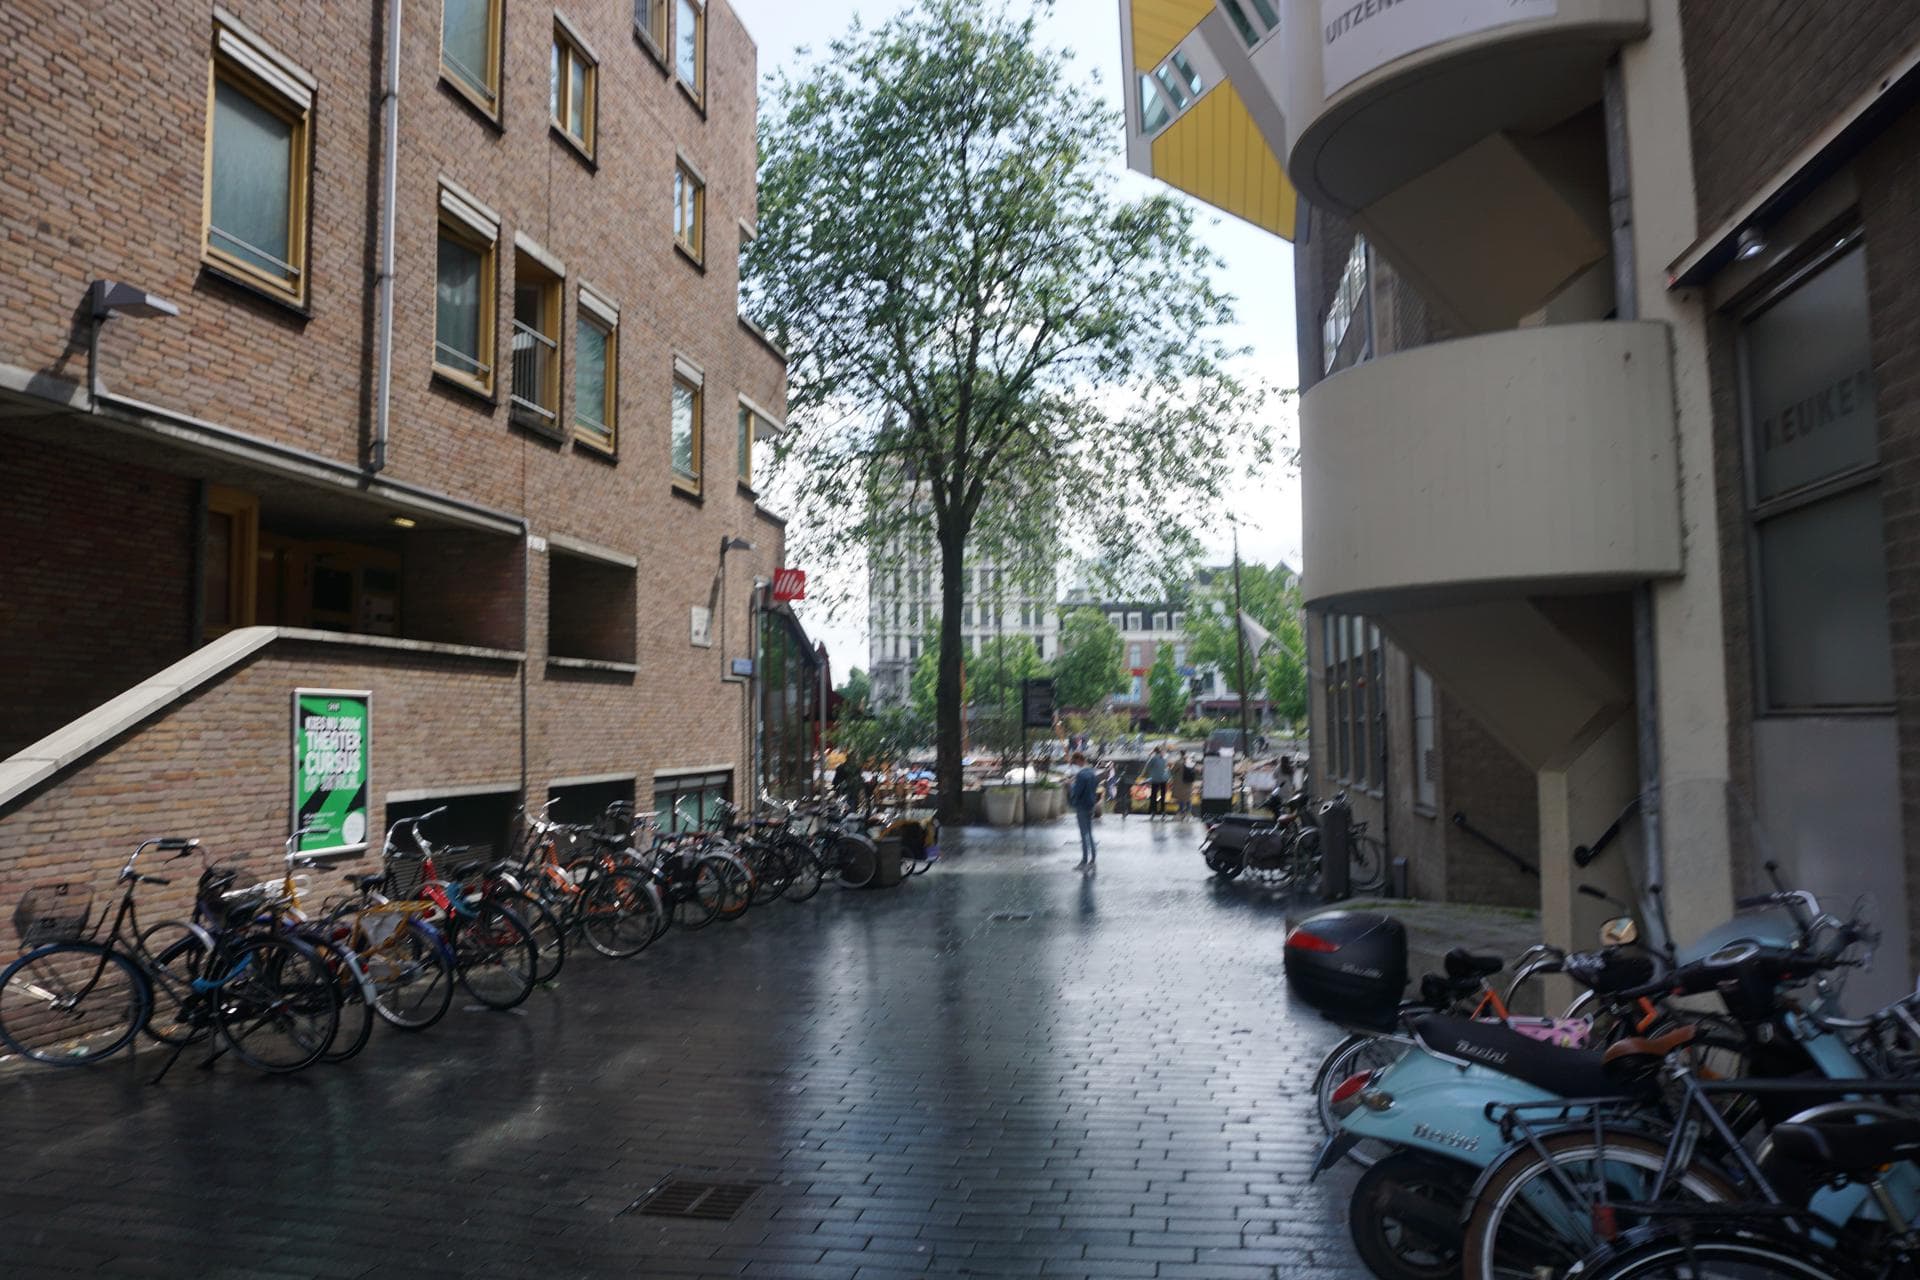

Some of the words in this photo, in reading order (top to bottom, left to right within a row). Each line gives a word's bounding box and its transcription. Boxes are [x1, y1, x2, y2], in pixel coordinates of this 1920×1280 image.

[1326, 0, 1405, 44] UITZEN
[775, 571, 804, 597] illy
[305, 730, 362, 750] THEATER
[304, 750, 361, 775] CURSUS
